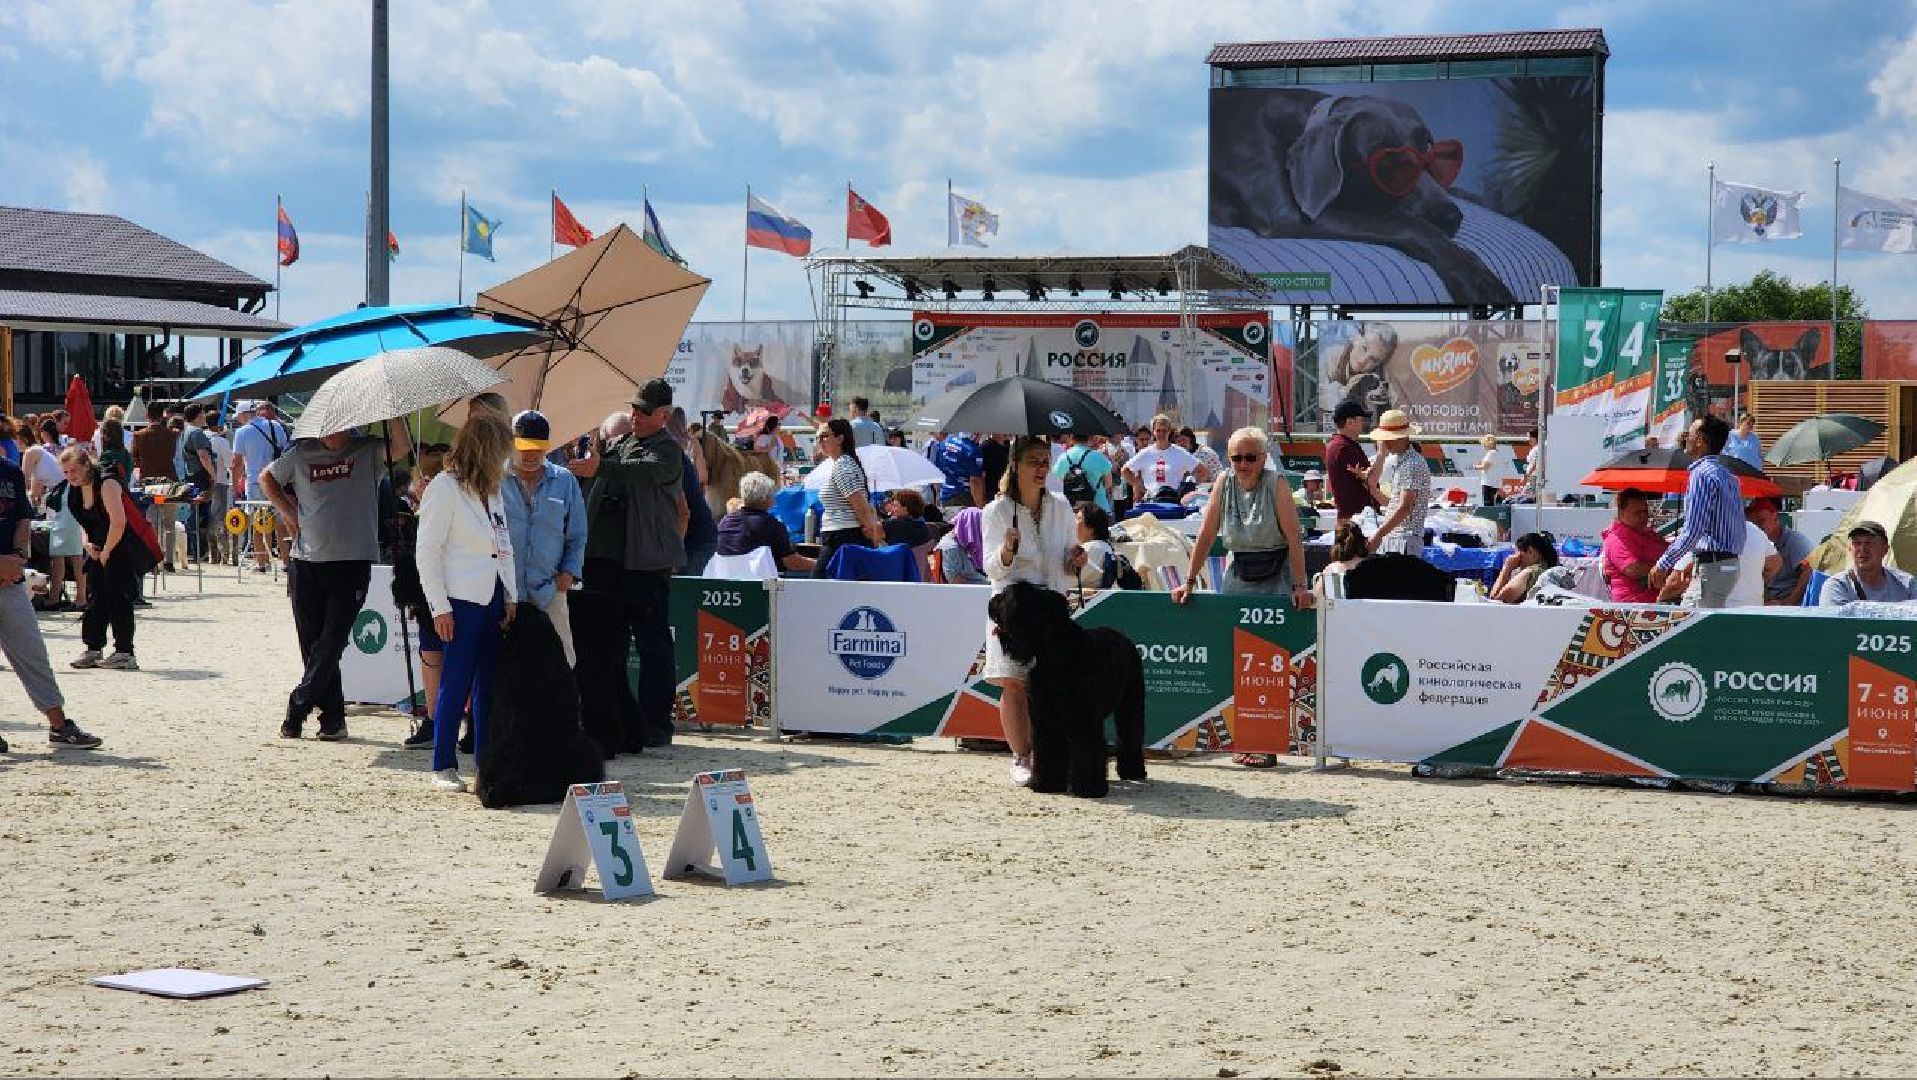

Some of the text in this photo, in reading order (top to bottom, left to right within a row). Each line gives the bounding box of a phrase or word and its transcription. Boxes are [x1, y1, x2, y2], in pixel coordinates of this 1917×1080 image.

[1583, 319, 1605, 368] 3
[1620, 321, 1645, 366] 4
[1048, 352, 1127, 368] РОССИЯ
[1409, 404, 1480, 416] ЛЮБОВЬЮ
[702, 590, 742, 607] 2025
[1239, 607, 1285, 625] 2025
[834, 632, 902, 654] Farmina
[1856, 633, 1912, 653] 2025
[703, 654, 741, 665] ИЮНЯ
[1135, 643, 1208, 664] ОССИЯ
[1418, 658, 1493, 673] Российская
[1240, 676, 1284, 688] ИЮНЯ
[1418, 677, 1522, 691] кинологическая
[1713, 670, 1817, 694] РОССИЯ
[1418, 691, 1489, 706] федерация
[1857, 706, 1909, 720] ИЮНЯ
[732, 809, 757, 872] 4
[599, 821, 633, 887] 3
